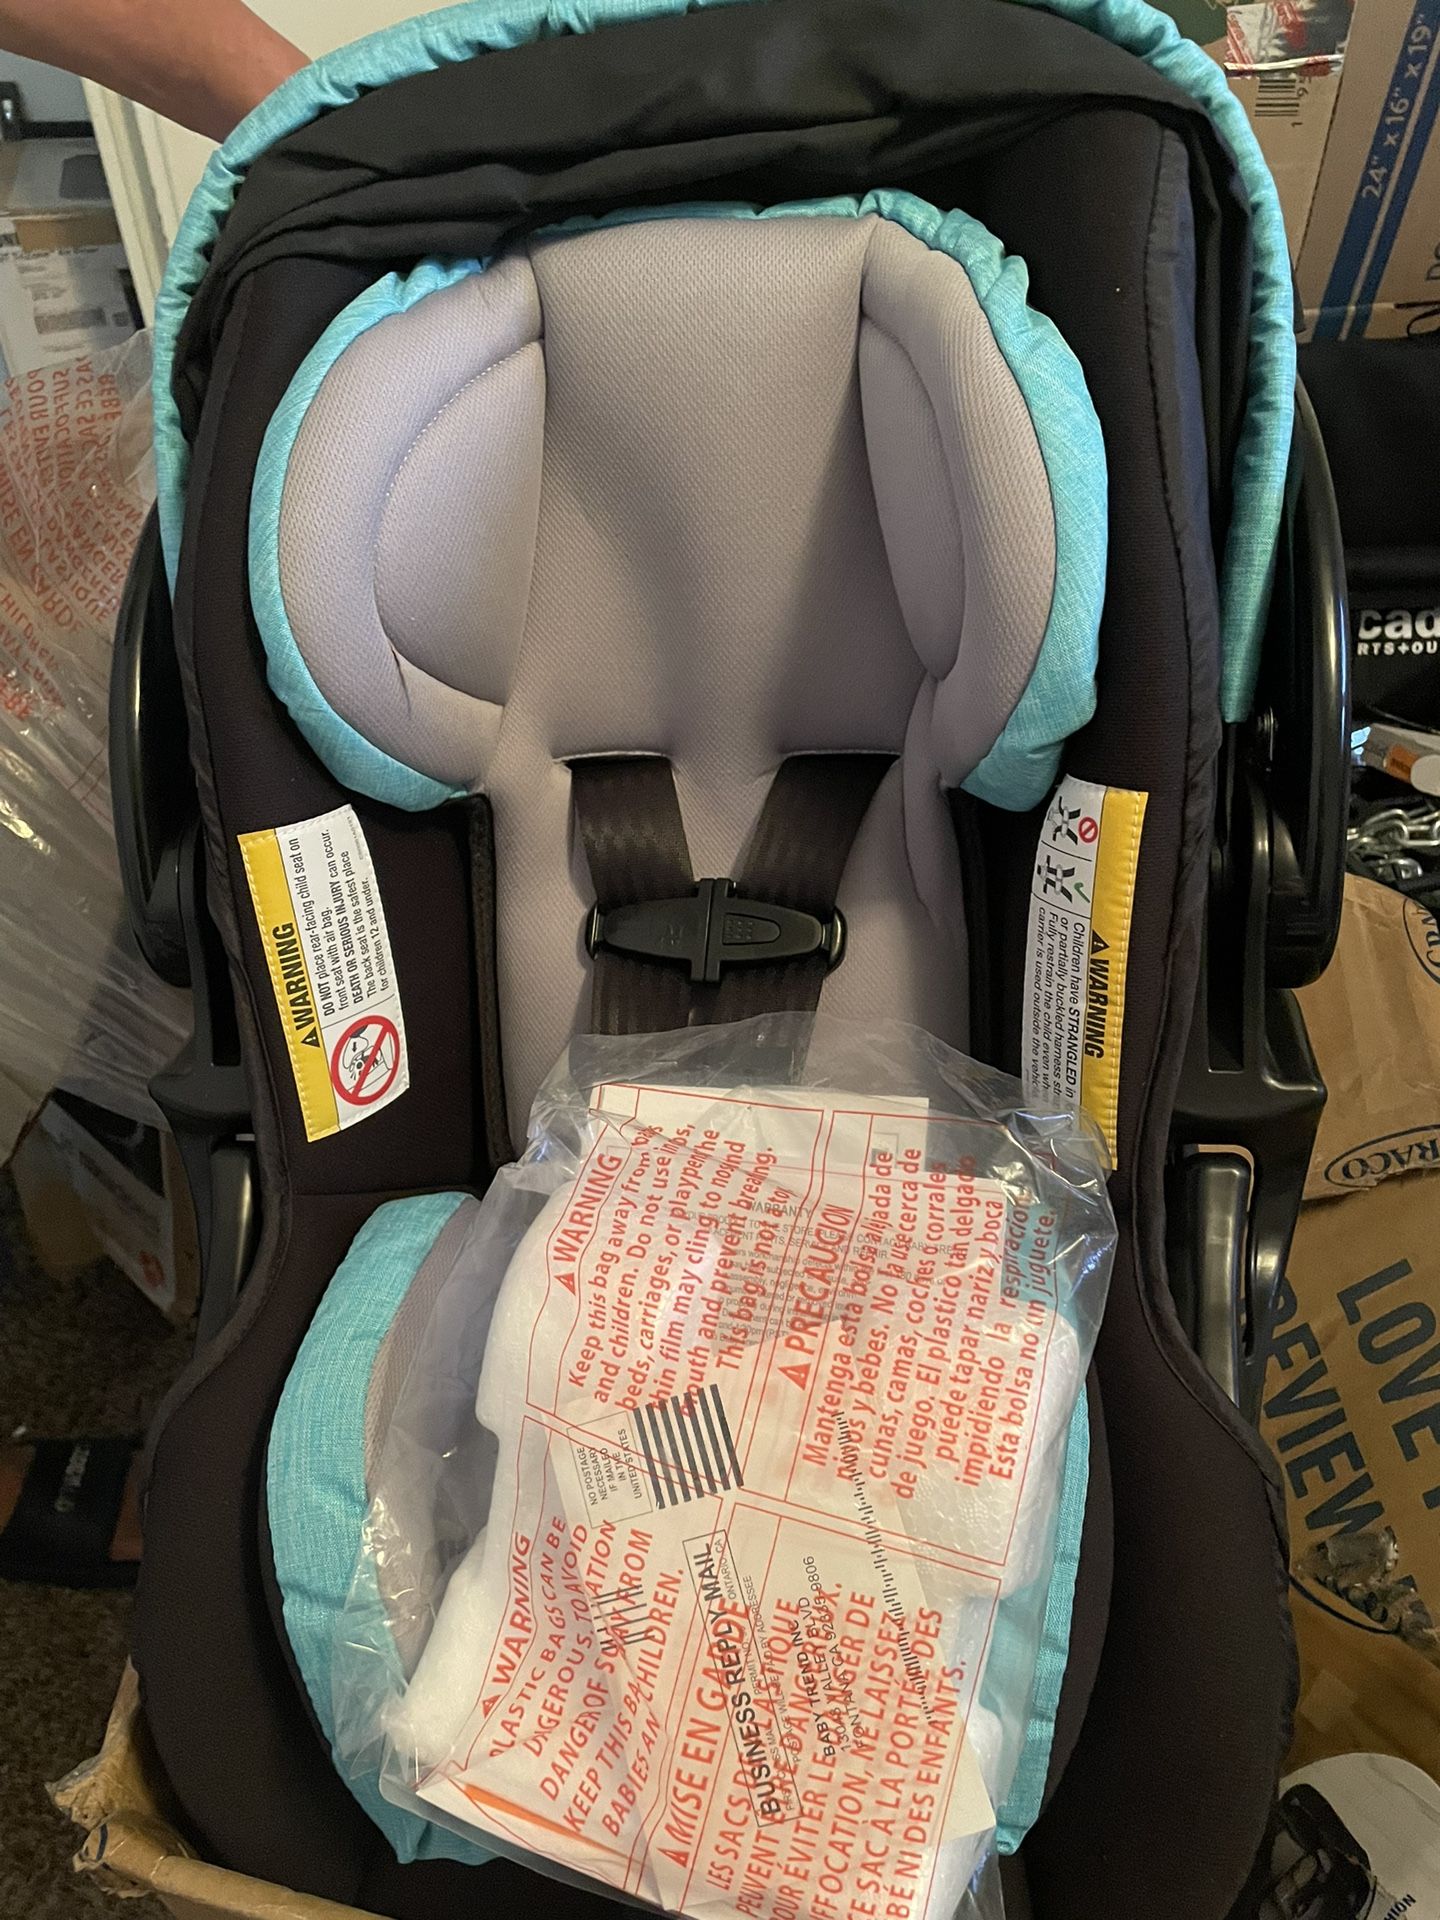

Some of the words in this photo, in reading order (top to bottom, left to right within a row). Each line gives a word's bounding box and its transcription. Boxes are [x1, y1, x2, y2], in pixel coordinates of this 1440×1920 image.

[288, 837, 300, 851] on
[289, 851, 305, 874] seat
[321, 829, 335, 859] occur.
[340, 850, 355, 877] place
[293, 874, 311, 899] child
[327, 859, 339, 878] can
[328, 880, 347, 915] INJURY
[344, 877, 360, 907] safest
[361, 877, 374, 906] under.
[301, 899, 322, 952] rear-facing
[320, 906, 333, 929] bag.
[323, 930, 336, 943] air
[337, 915, 355, 957] SERIOUS
[352, 907, 363, 924] the
[354, 924, 365, 934] is
[365, 907, 378, 925] and
[369, 926, 380, 939] 12
[1037, 906, 1046, 946] carrier
[1045, 911, 1058, 941] Fully
[1060, 917, 1069, 931] or
[326, 943, 340, 966] with
[345, 957, 358, 972] OR
[356, 934, 370, 955] seat
[373, 939, 387, 975] children
[1036, 947, 1044, 958] is
[1044, 943, 1053, 988] restrain
[1054, 931, 1068, 981] partially
[1070, 922, 1085, 972] Children
[272, 922, 315, 1030] WARNING
[313, 953, 329, 979] place
[330, 965, 345, 987] seat
[360, 955, 374, 979] back
[379, 977, 389, 991] for
[1033, 960, 1043, 991] used
[317, 981, 332, 1000] NOT
[321, 1001, 335, 1016] DO
[334, 986, 349, 1010] front
[348, 973, 364, 1003] DEATH
[366, 979, 377, 998] The
[1043, 990, 1054, 1009] the
[1054, 982, 1066, 1031] buckled
[1068, 975, 1082, 1004] have
[1084, 957, 1109, 1058] WARNING
[1032, 992, 1041, 1035] outside
[1043, 1011, 1052, 1041] child
[1031, 1037, 1040, 1055] the
[1042, 1042, 1050, 1070] even
[1052, 1031, 1064, 1079] harness
[1065, 1006, 1080, 1085] STRANGLED
[1065, 1086, 1076, 1098] in
[619, 1151, 650, 1193] from
[869, 1152, 892, 1178] de
[896, 1148, 921, 1174] de
[552, 1154, 622, 1263] WARNING
[699, 1193, 721, 1210] to
[897, 1179, 919, 1233] cerca
[923, 1158, 950, 1243] corrales
[608, 1196, 637, 1248] away
[684, 1214, 720, 1265] cling
[753, 1220, 779, 1255] not
[974, 1199, 1004, 1245] boca
[709, 1212, 747, 1294] prevent
[746, 1259, 767, 1276] is
[891, 1233, 912, 1261] use
[944, 1242, 968, 1269] tan
[1027, 1209, 1058, 1295] juguete.
[588, 1251, 621, 1289] bag
[592, 1359, 620, 1403] and
[607, 1272, 637, 1359] children.
[625, 1233, 651, 1259] Do
[639, 1194, 661, 1226] not
[652, 1157, 671, 1189] use
[671, 1267, 702, 1314] may
[782, 1205, 851, 1355] PRECAUCION
[842, 1245, 878, 1297] bolsa
[588, 1293, 605, 1330] this
[729, 1280, 766, 1322] bag
[870, 1283, 898, 1314] No
[904, 1259, 936, 1325] coches
[965, 1264, 995, 1320] nariz
[614, 1356, 653, 1410] beds,
[638, 1250, 677, 1350] carriages,
[663, 1223, 681, 1246] or
[698, 1295, 722, 1340] and
[837, 1303, 864, 1348] esta
[923, 1274, 964, 1362] plastico
[568, 1335, 602, 1387] Keep
[659, 1320, 682, 1361] film
[714, 1326, 749, 1370] This
[849, 1325, 889, 1396] bebes.
[947, 1325, 980, 1386] tapar
[1019, 1332, 1039, 1360] no
[885, 1327, 924, 1404] camas,
[914, 1364, 941, 1386] El
[801, 1352, 854, 1466] Mantenga
[996, 1366, 1033, 1426] bolsa
[895, 1395, 936, 1468] juego.
[932, 1388, 968, 1461] puede
[955, 1355, 1005, 1487] impidiendo
[598, 1447, 615, 1482] MAILED
[611, 1451, 624, 1471] THE
[617, 1428, 634, 1464] STATES
[867, 1410, 903, 1479] cunas,
[987, 1432, 1019, 1480] Esta
[576, 1446, 595, 1490] POSTAGE
[586, 1445, 608, 1501] NECESSARY
[608, 1484, 618, 1492] IF
[617, 1471, 626, 1481] IN
[627, 1464, 643, 1499] UNITED
[890, 1471, 917, 1499] de
[588, 1491, 598, 1505] NO
[544, 1519, 565, 1549] BE
[540, 1553, 556, 1601] CAN
[563, 1523, 589, 1594] AVOID
[692, 1542, 723, 1602] MAIL
[491, 1536, 532, 1684] WARNING
[797, 1596, 819, 1638] BLVD
[539, 1606, 565, 1662] BAGS
[706, 1608, 746, 1686] REPLY
[908, 1608, 942, 1660] DES
[694, 1598, 751, 1713] GARDE
[858, 1611, 906, 1719] LAISSEZ
[581, 1679, 609, 1709] OF
[796, 1650, 821, 1707] TREND
[680, 1717, 721, 1765] EN
[777, 1790, 826, 1880] ÉVITER
[843, 1593, 875, 1630] DE
[814, 1713, 836, 1757] BABY
[913, 1655, 967, 1787] ENFANTS.
[730, 1691, 781, 1817] BUSINESS
[848, 1726, 880, 1761] NE
[559, 1767, 601, 1832] KEEP
[594, 1711, 636, 1769] THIS
[602, 1752, 649, 1836] BABIES
[664, 1768, 708, 1845] MISE
[873, 1777, 906, 1809] LA
[713, 1795, 752, 1862] SACS
[859, 1811, 896, 1837] À
[901, 1793, 934, 1844] DES
[707, 1861, 735, 1891] LES
[732, 1828, 780, 1918] PEUVENT
[854, 1839, 889, 1894] SAC
[892, 1850, 921, 1879] NI
